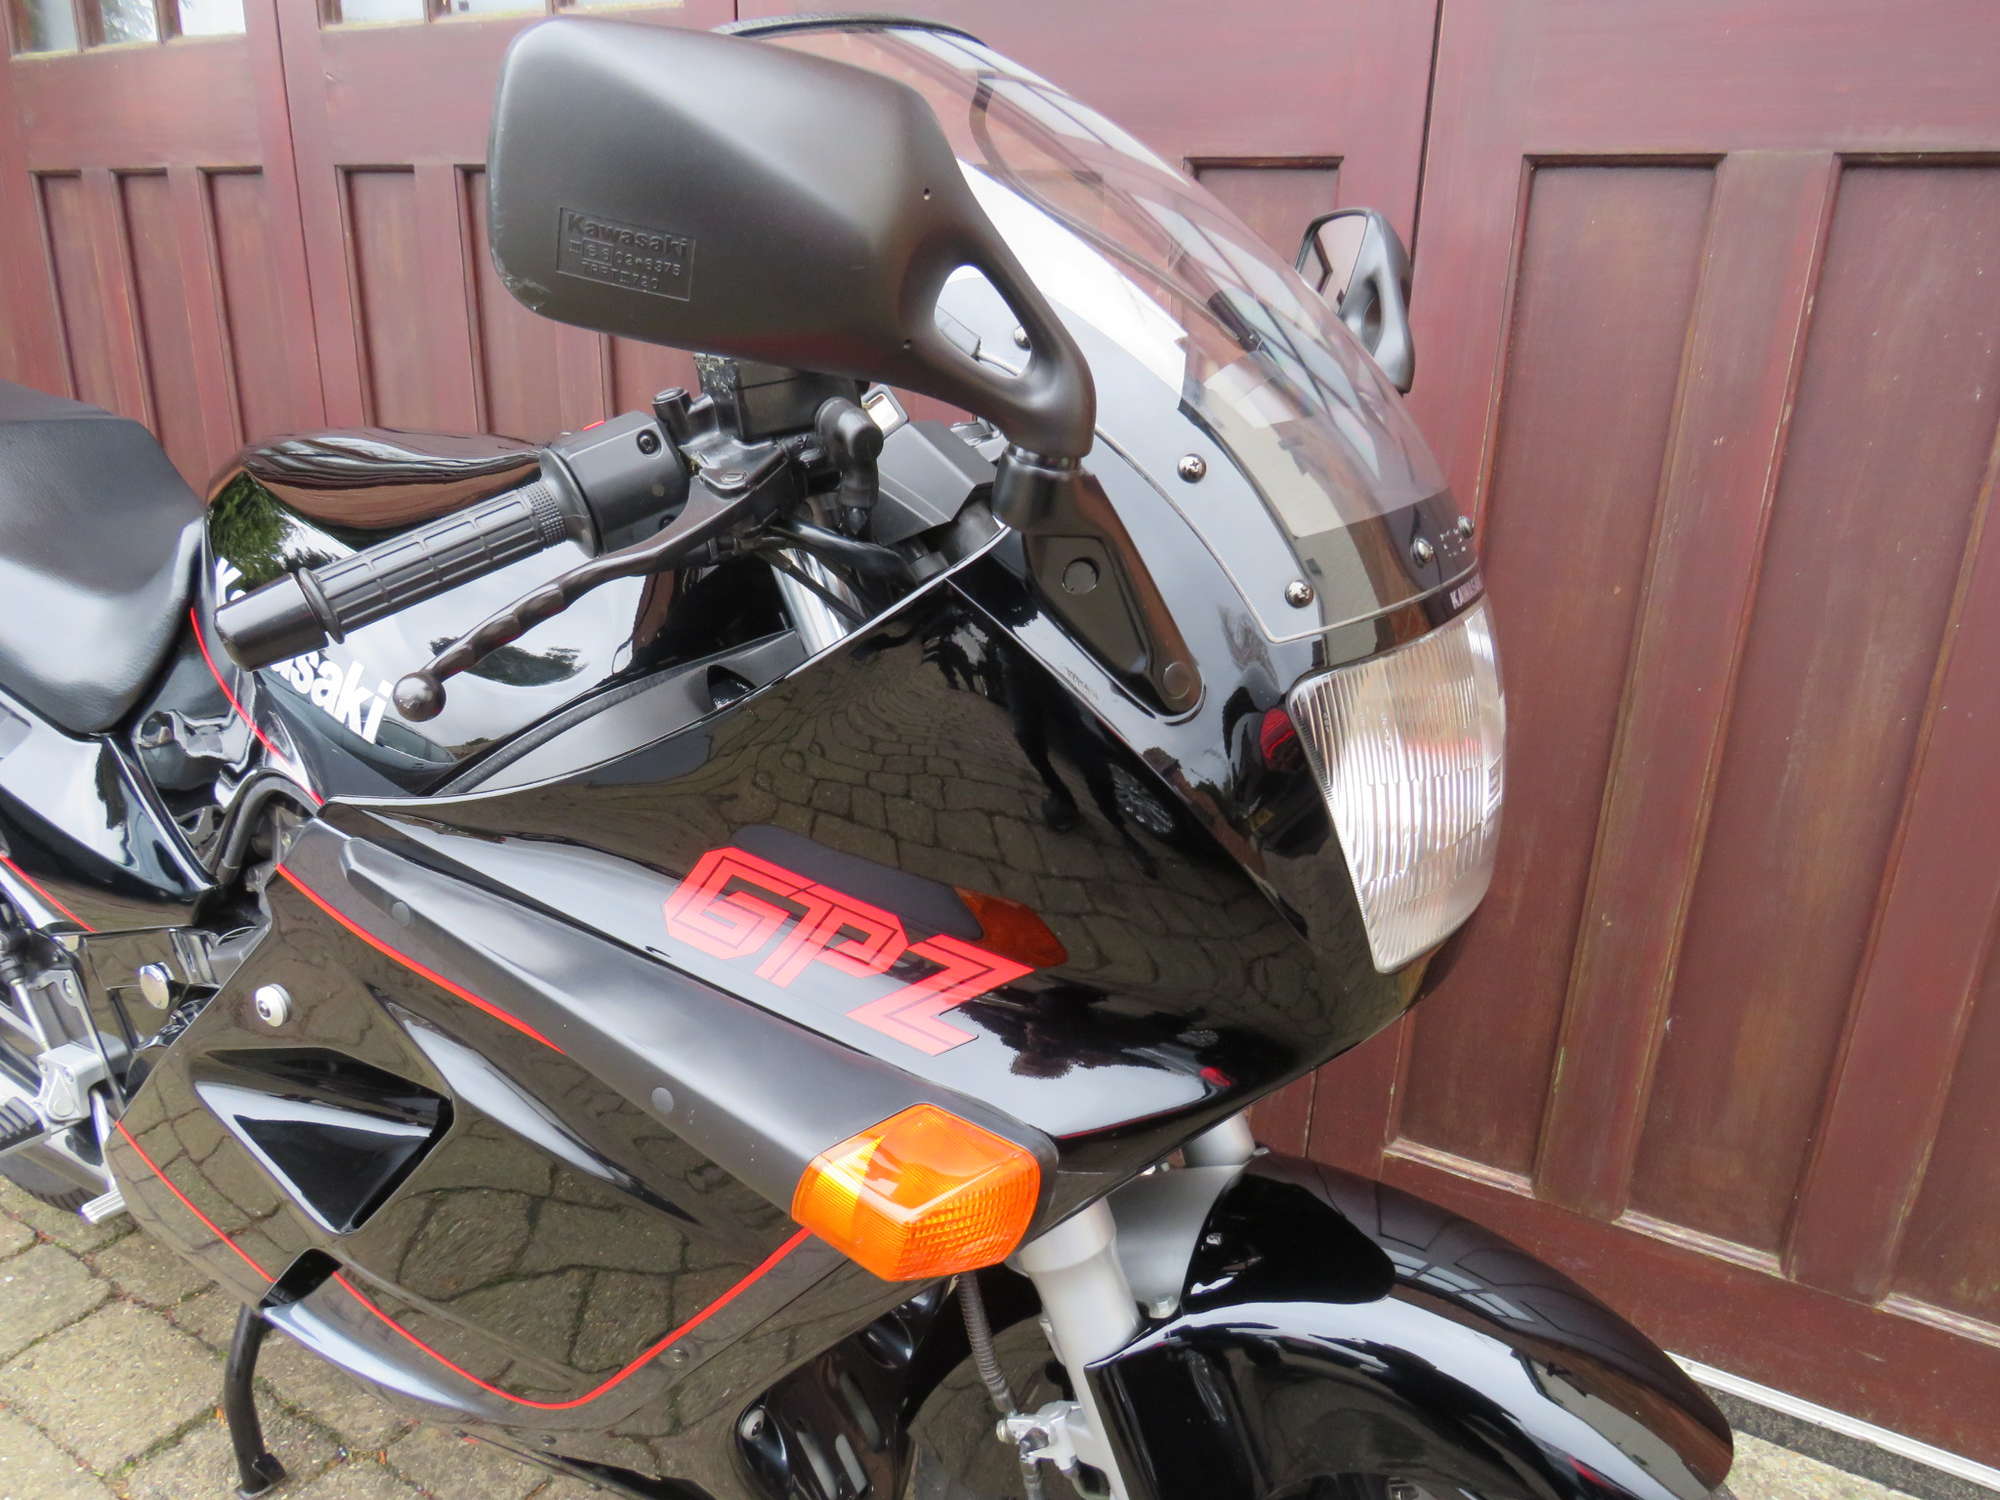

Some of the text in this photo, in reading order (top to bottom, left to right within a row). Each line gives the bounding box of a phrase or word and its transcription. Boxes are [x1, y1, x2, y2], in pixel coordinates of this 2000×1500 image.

[568, 212, 687, 257] Kawasaki
[216, 556, 394, 744] Ksaki
[664, 846, 1035, 1056] GPZ
